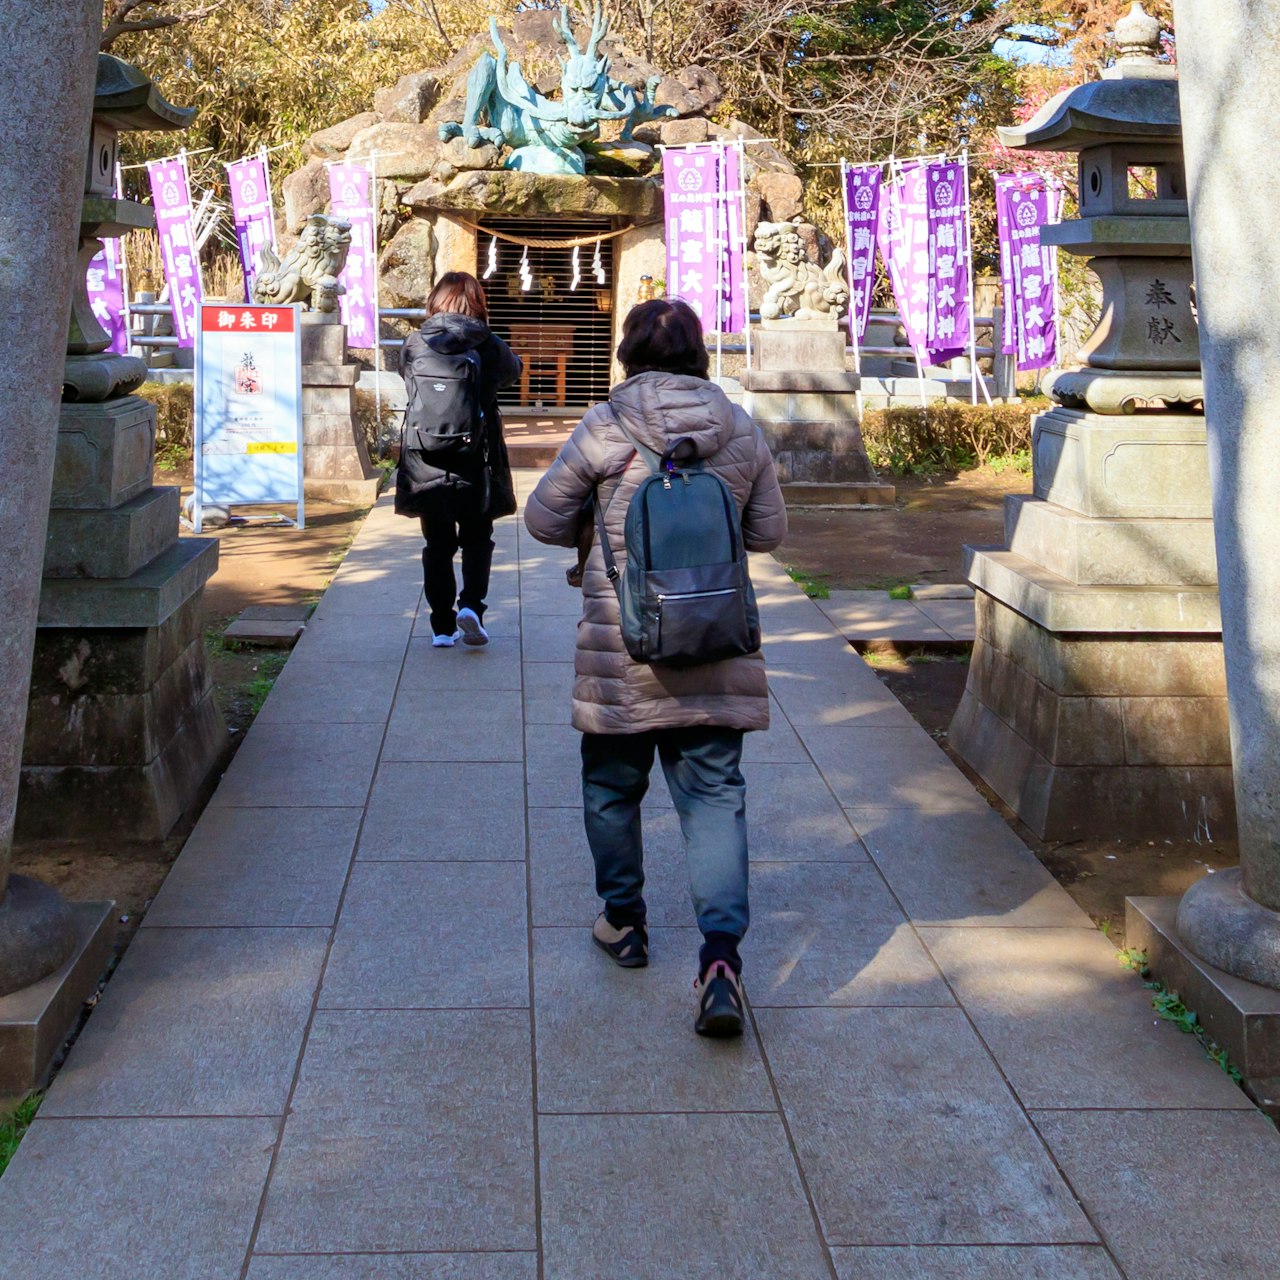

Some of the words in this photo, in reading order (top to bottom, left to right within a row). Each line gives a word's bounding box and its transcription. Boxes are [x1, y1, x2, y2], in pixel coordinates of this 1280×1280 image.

[217, 310, 278, 330] 御朱印
[936, 223, 956, 339] 龍宮大神
[1021, 243, 1045, 360] 龍宮大神
